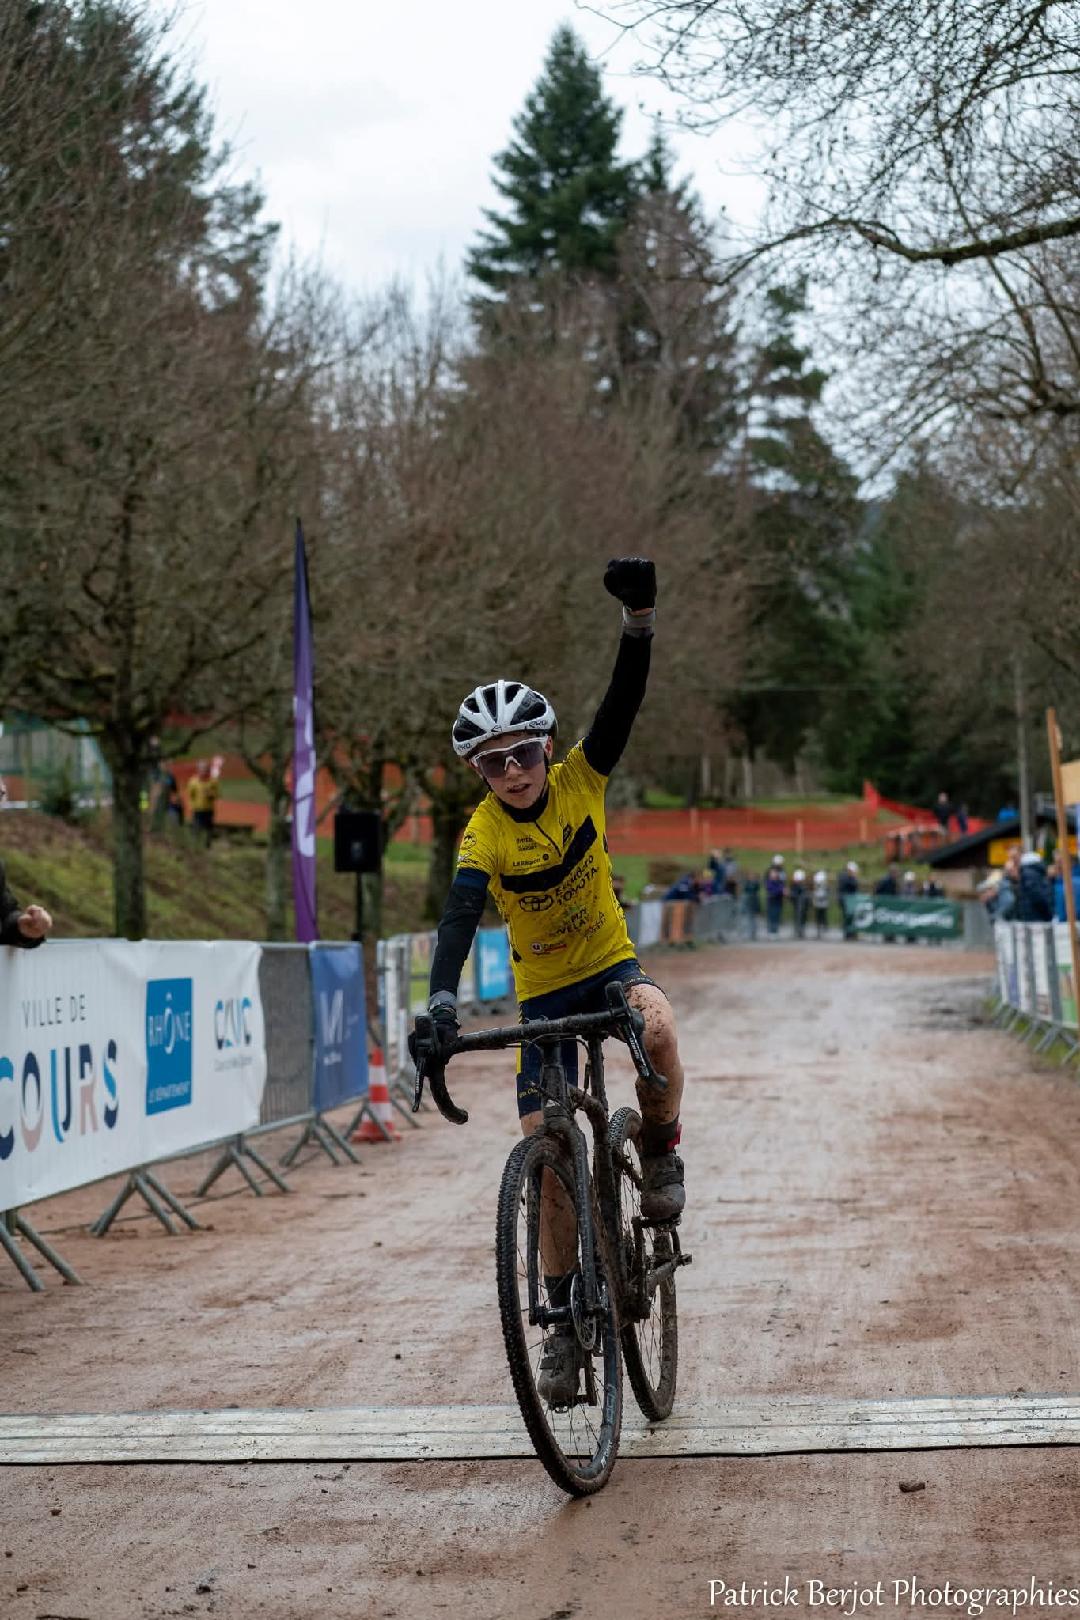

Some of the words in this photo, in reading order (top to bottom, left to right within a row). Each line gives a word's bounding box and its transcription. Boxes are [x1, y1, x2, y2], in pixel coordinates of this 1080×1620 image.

[22, 997, 63, 1028] VILLE
[70, 994, 87, 1022] DE
[0, 1039, 119, 1161] COURS
